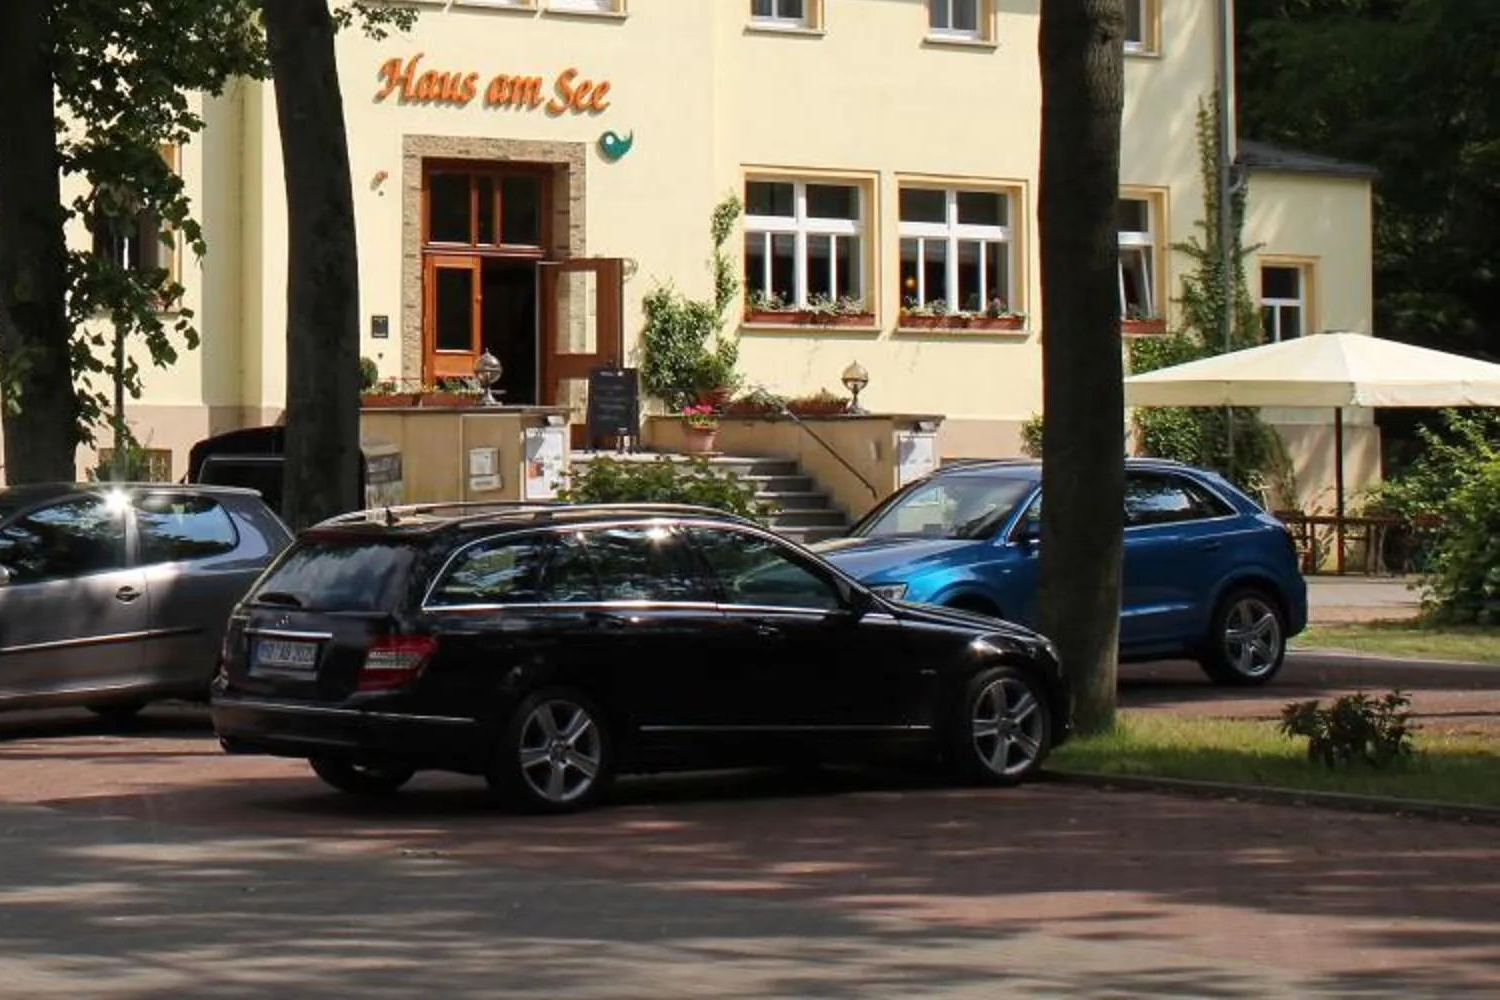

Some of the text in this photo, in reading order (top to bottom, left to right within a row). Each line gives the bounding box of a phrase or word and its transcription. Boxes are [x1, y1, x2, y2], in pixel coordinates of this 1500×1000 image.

[374, 52, 611, 116] Haus am See
